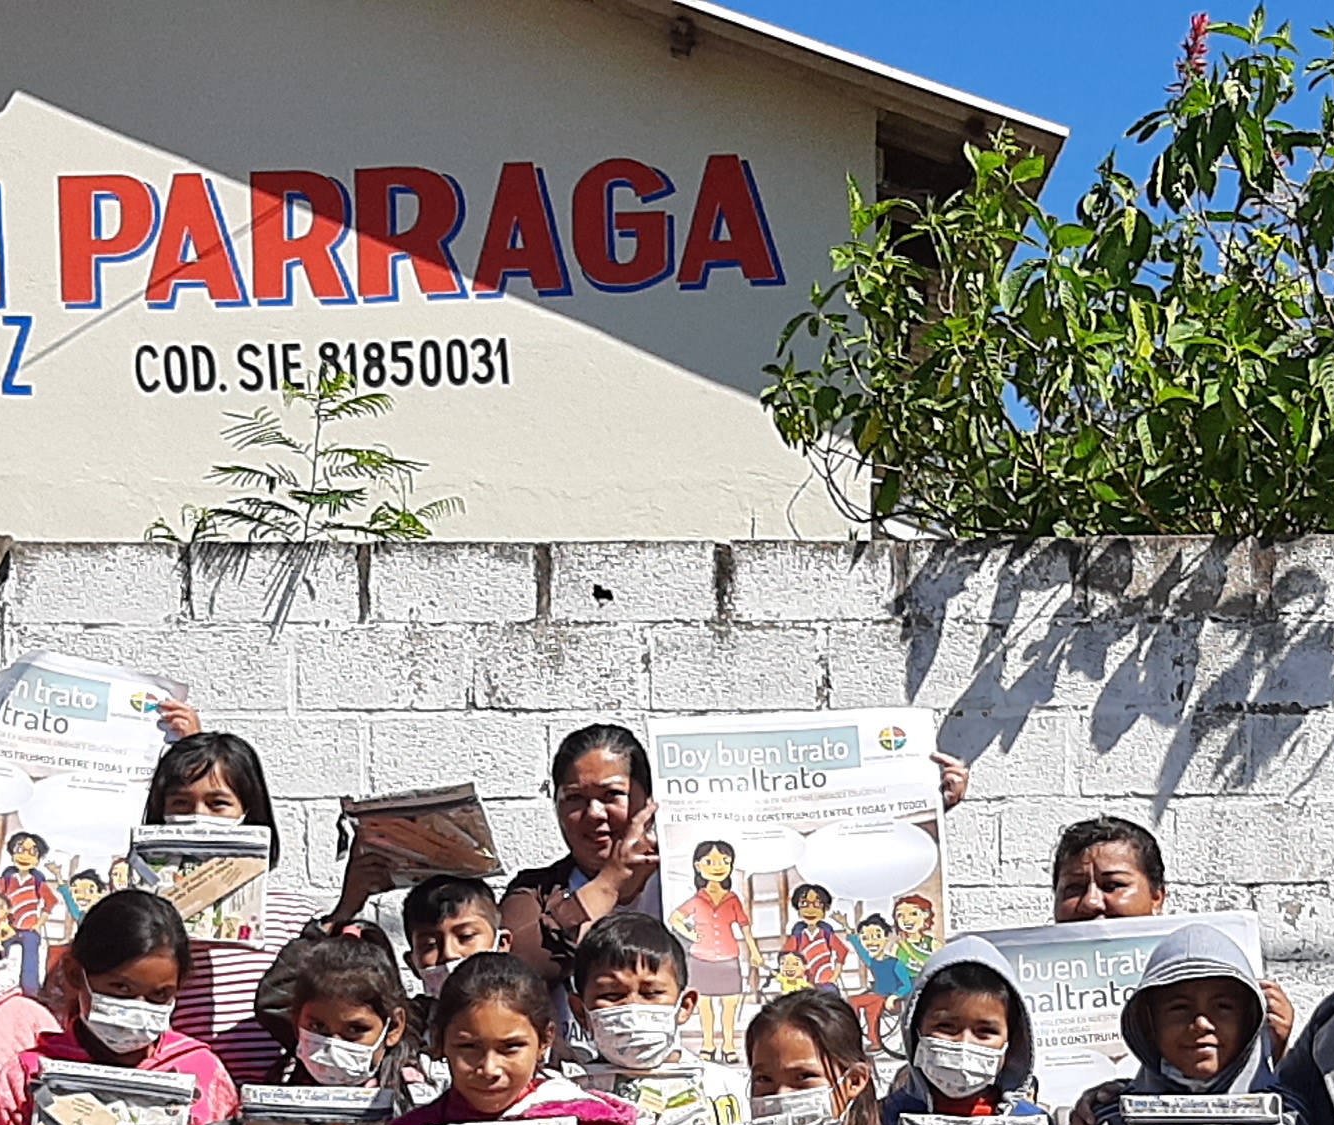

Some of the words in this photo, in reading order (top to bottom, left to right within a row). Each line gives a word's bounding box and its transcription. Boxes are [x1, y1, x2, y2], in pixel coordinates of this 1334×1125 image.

[57, 153, 787, 309] PARRAGA
[134, 344, 227, 395] COD.
[236, 342, 304, 393] SIE
[318, 337, 513, 395] 81850031
[33, 677, 99, 711] trato
[662, 741, 712, 774] Doy
[717, 738, 782, 768] buen
[786, 735, 849, 765] trato
[666, 776, 699, 795] no
[708, 766, 827, 794] maltrato
[1018, 953, 1088, 983] buen
[1094, 946, 1151, 977] trat
